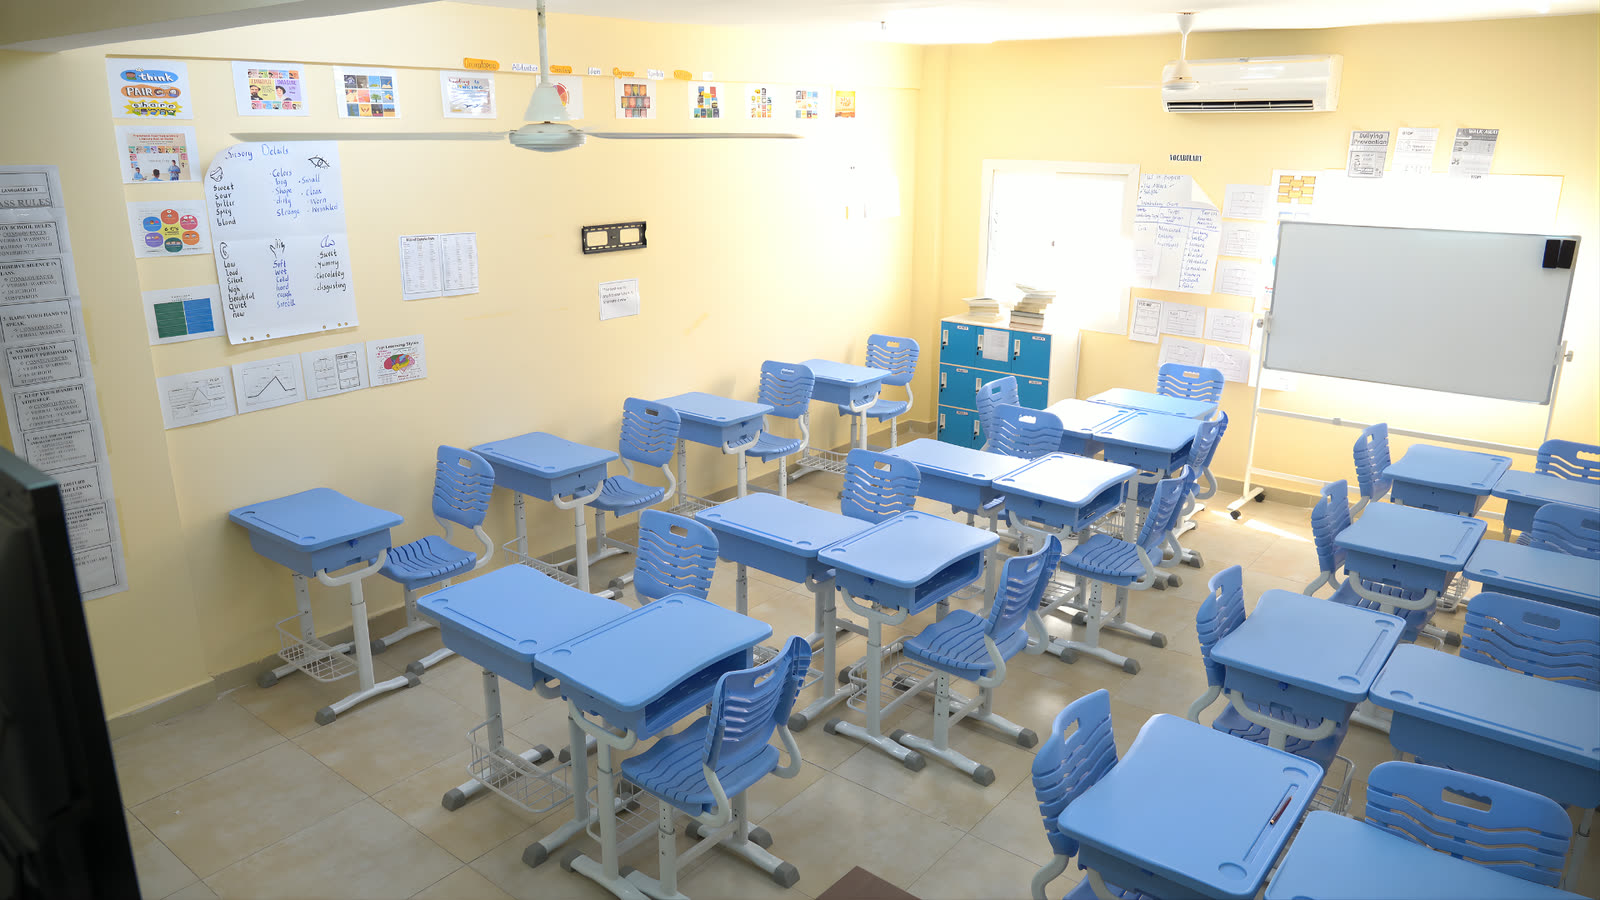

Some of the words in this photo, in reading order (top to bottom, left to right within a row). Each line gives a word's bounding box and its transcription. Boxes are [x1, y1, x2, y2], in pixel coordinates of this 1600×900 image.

[138, 73, 174, 82] think
[126, 87, 152, 96] PAIR
[262, 144, 289, 156] Details
[18, 198, 51, 207] RULES
